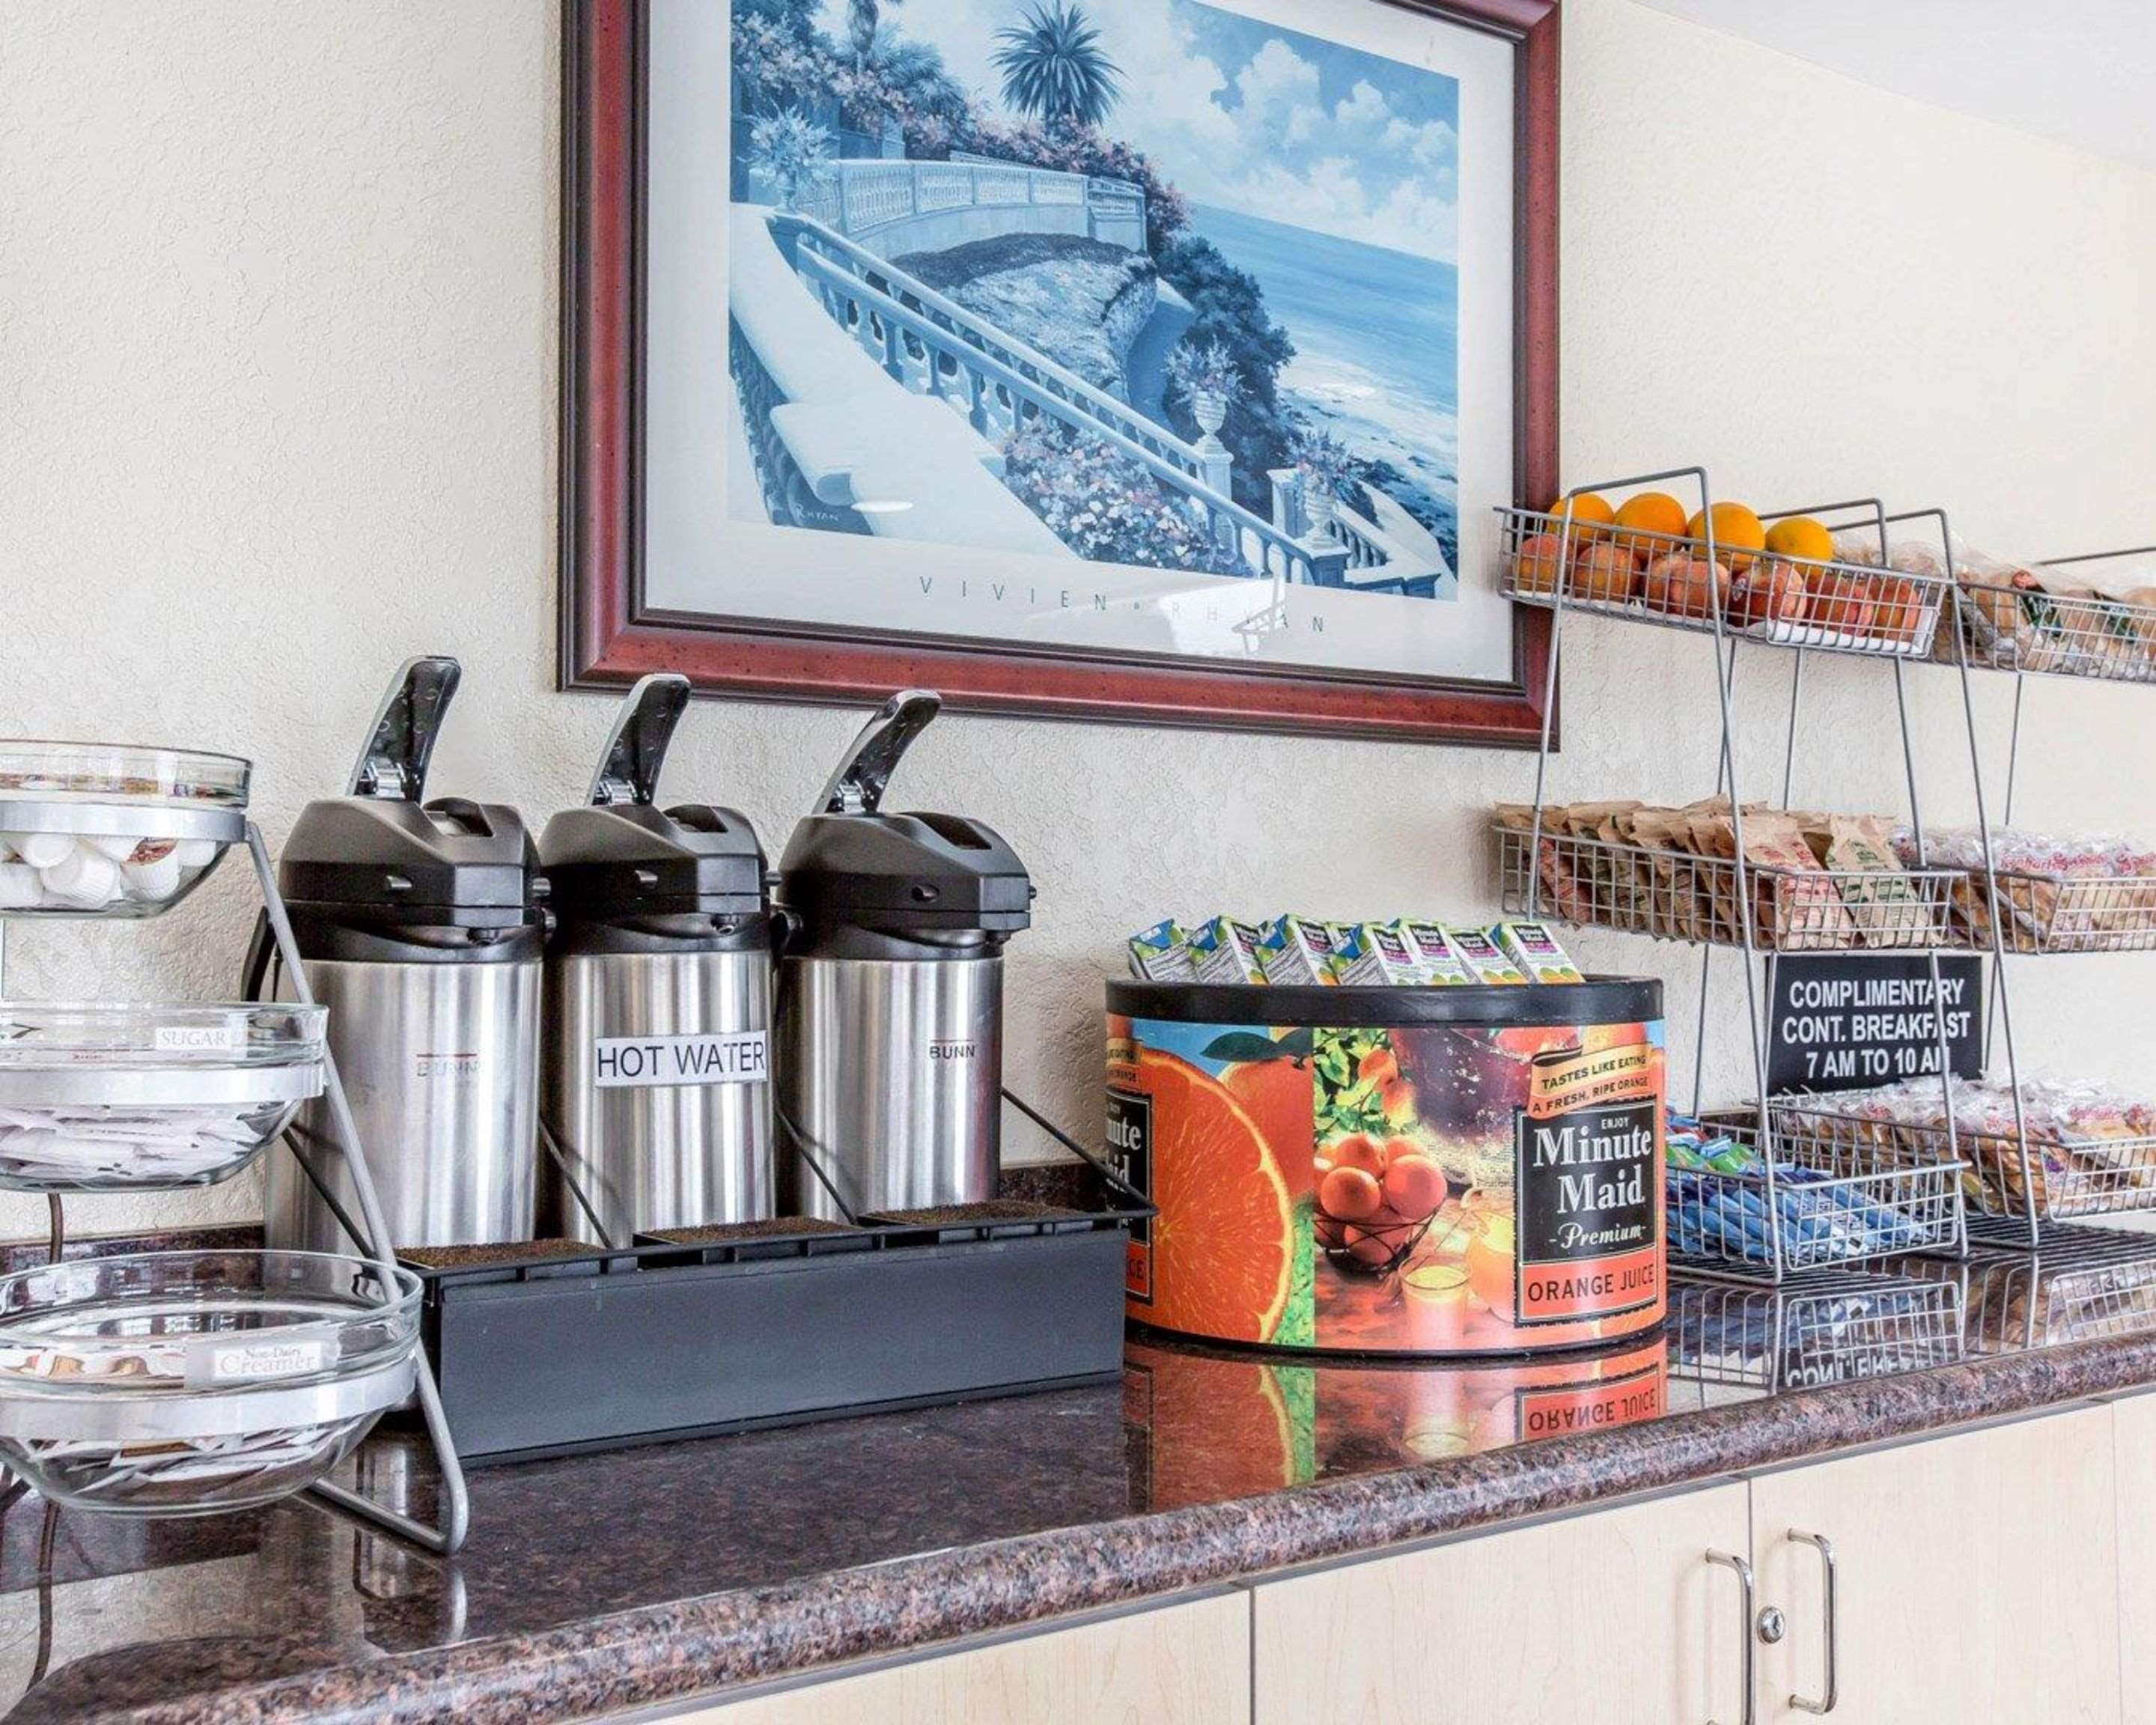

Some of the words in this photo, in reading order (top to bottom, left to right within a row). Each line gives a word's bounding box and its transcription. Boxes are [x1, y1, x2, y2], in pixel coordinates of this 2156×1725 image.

[919, 576, 1107, 611] VIVIEN
[162, 1030, 226, 1046] SUGAR
[1782, 1016, 1846, 1043] CONT.
[598, 1047, 664, 1077] HOT
[674, 1041, 764, 1075] WATER
[929, 1044, 975, 1059] BUNN
[1806, 1051, 1818, 1078] 7
[1823, 1050, 1855, 1077] AM
[1861, 1048, 1889, 1075] TO
[1895, 1048, 1916, 1074] 10
[1541, 1067, 1589, 1090] TASTES
[1592, 1060, 1616, 1075] LIKE
[1618, 1055, 1647, 1068] EATING
[1532, 1102, 1542, 1113] A
[1592, 1083, 1616, 1097] RIPE
[1618, 1077, 1648, 1091] ORANGE
[1601, 1116, 1629, 1130] ENJOY
[1533, 1125, 1652, 1166] Minute
[1557, 1163, 1645, 1214] Maid
[1528, 1274, 1614, 1302] ORANGE
[1621, 1263, 1654, 1292] JUICE
[221, 1354, 316, 1374] Creamer
